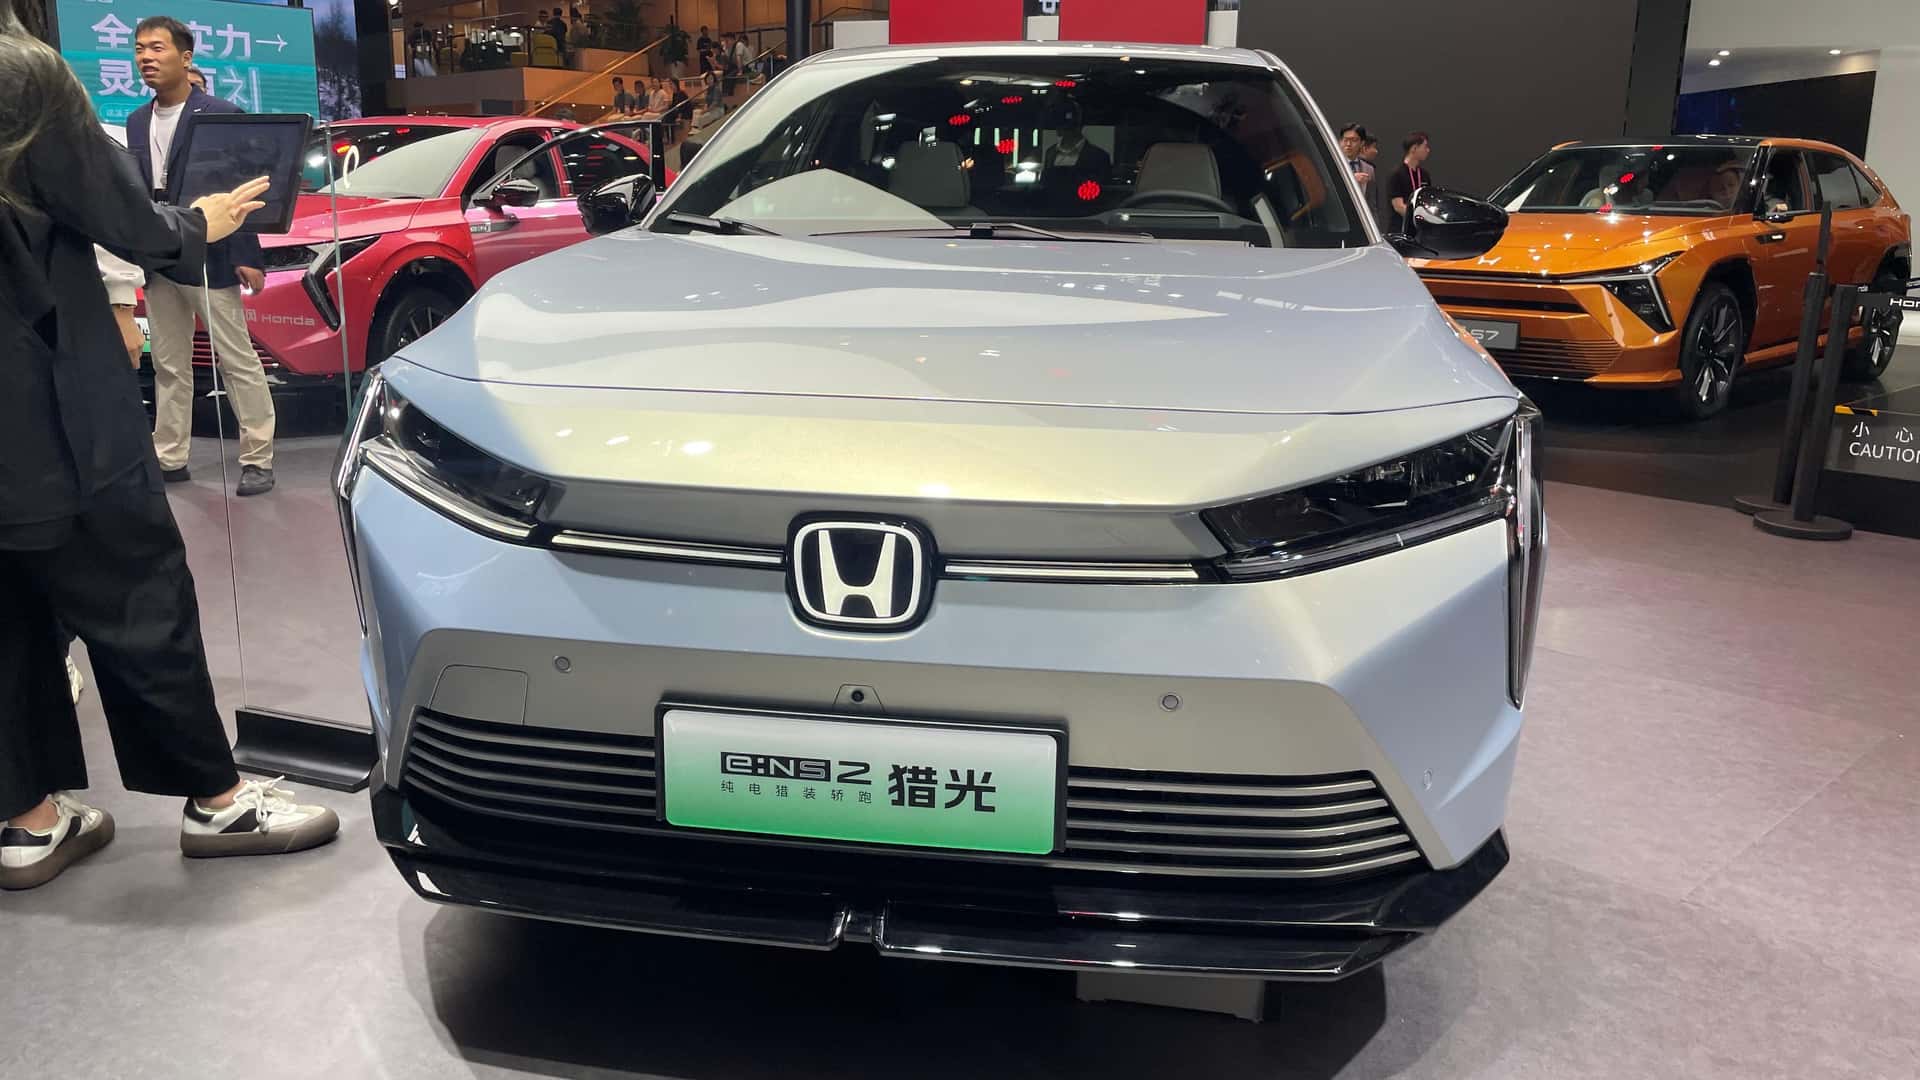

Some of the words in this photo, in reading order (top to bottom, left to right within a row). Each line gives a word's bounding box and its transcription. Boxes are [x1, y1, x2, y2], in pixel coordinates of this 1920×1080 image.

[91, 13, 251, 60] 全实力
[261, 313, 315, 326] Honda
[1852, 421, 1913, 443] 小心
[888, 764, 997, 812] 猎光
